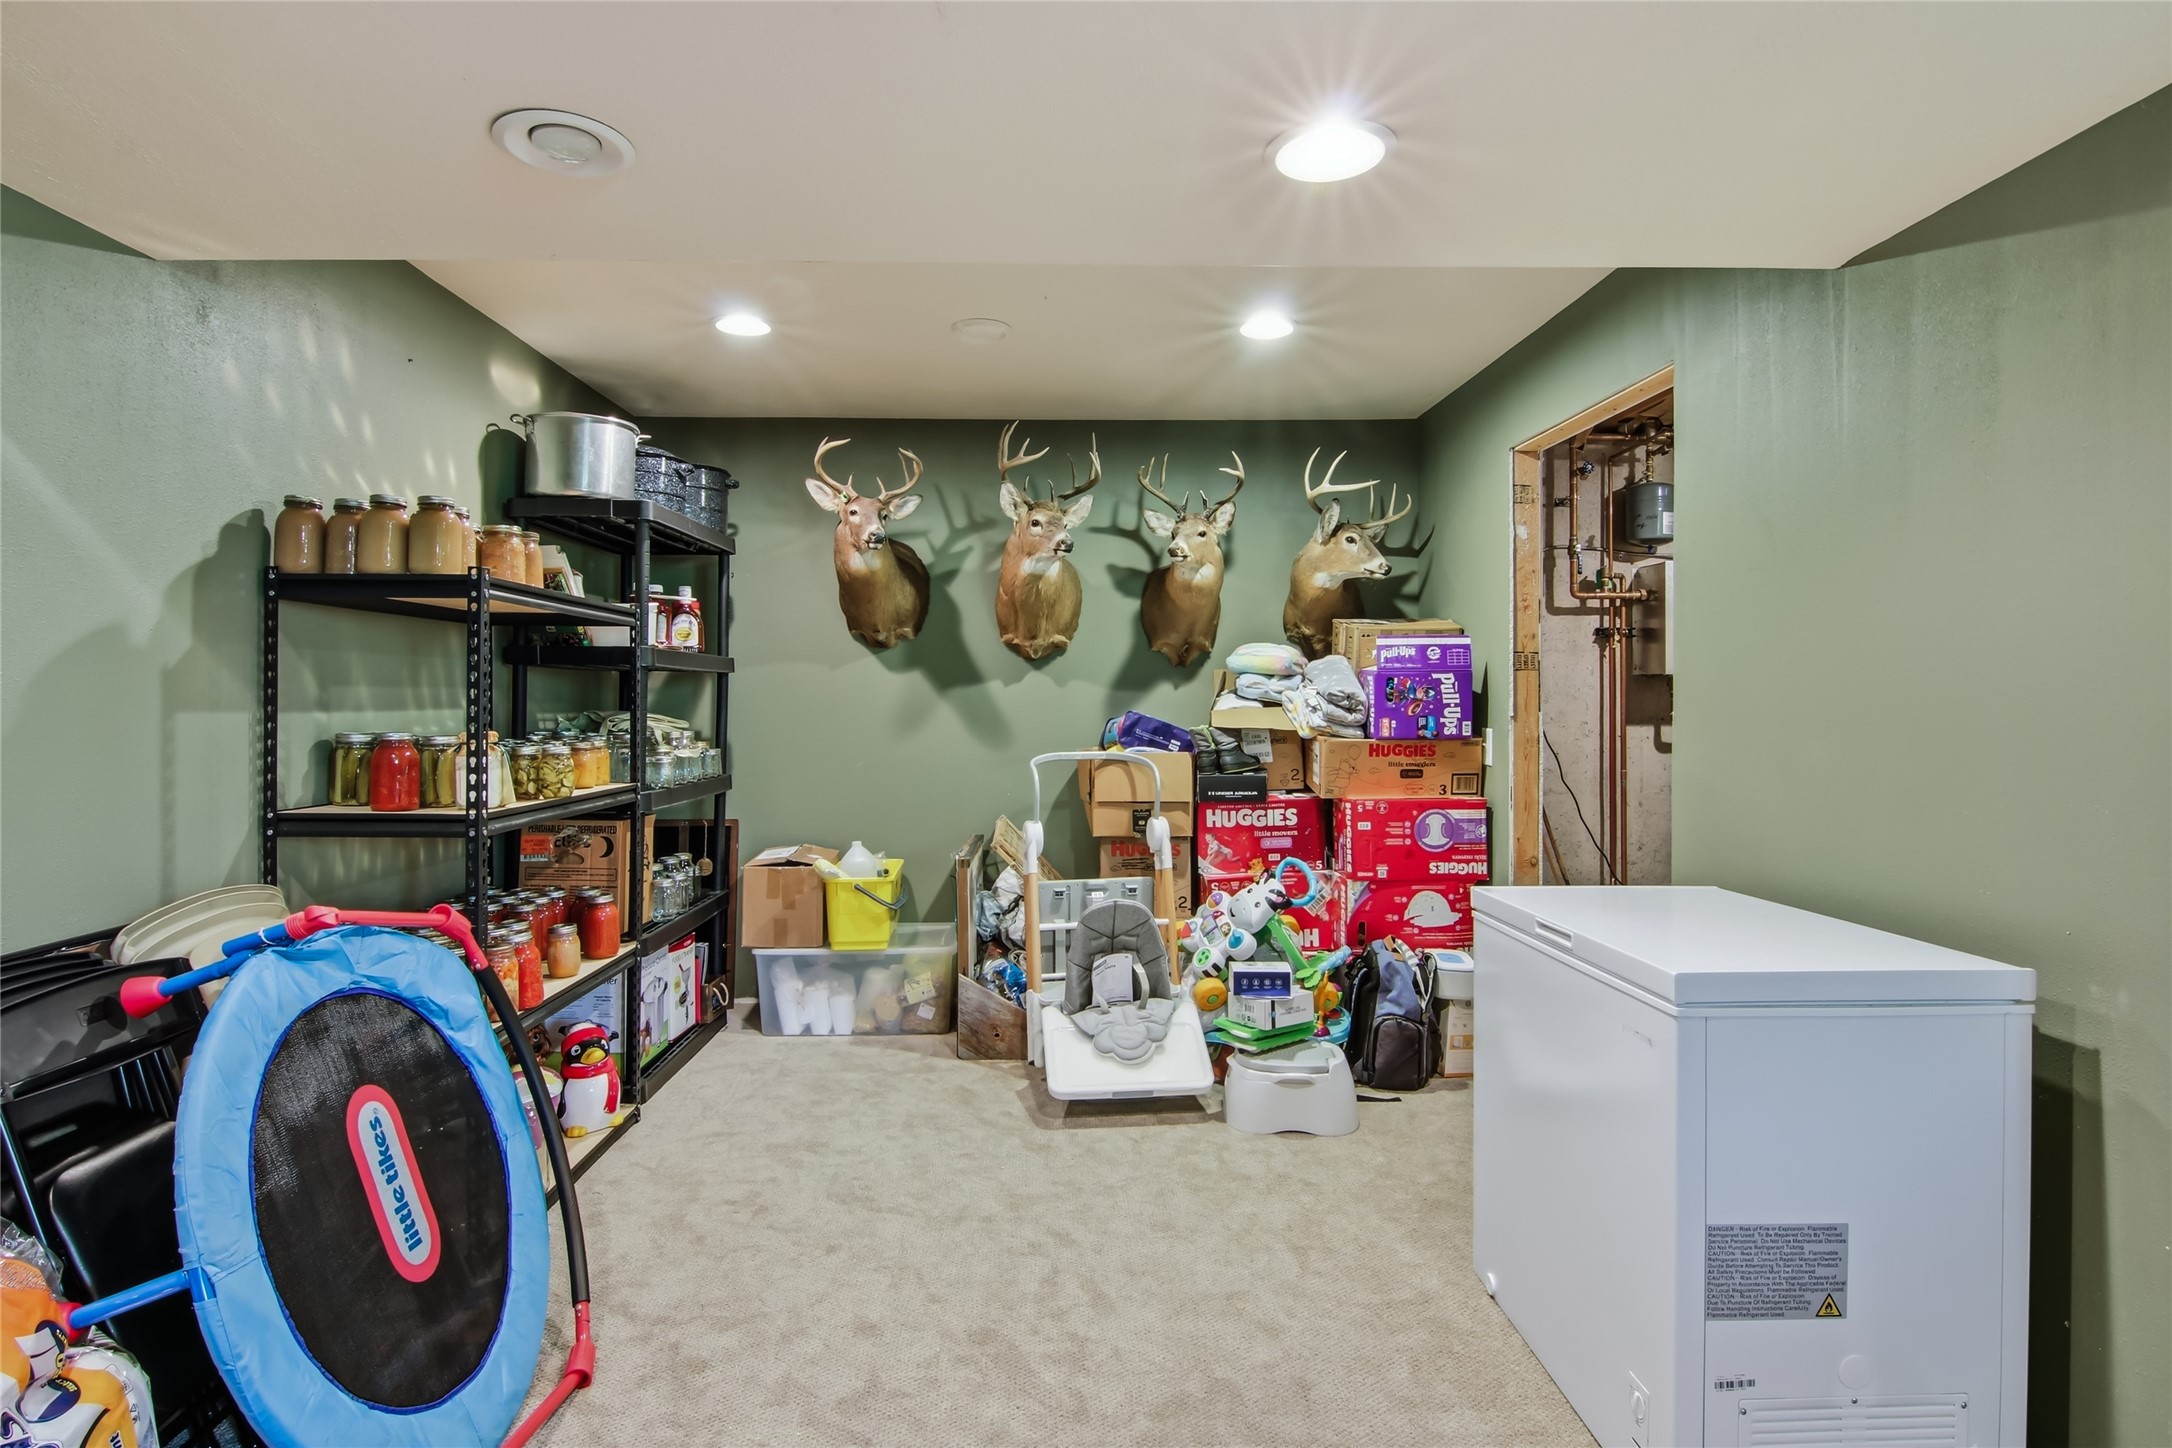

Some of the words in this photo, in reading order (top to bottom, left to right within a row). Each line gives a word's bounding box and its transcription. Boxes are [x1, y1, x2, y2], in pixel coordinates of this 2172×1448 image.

[1368, 744, 1436, 757] HUGGIES
[1290, 769, 1300, 780] 2
[1439, 784, 1447, 795] 3
[1206, 808, 1297, 828] HUGGIES
[1315, 861, 1322, 869] 5
[1429, 862, 1487, 874] HUGGIES
[1178, 896, 1187, 908] 2
[369, 1115, 400, 1186] tikes
[392, 1184, 423, 1252] little
